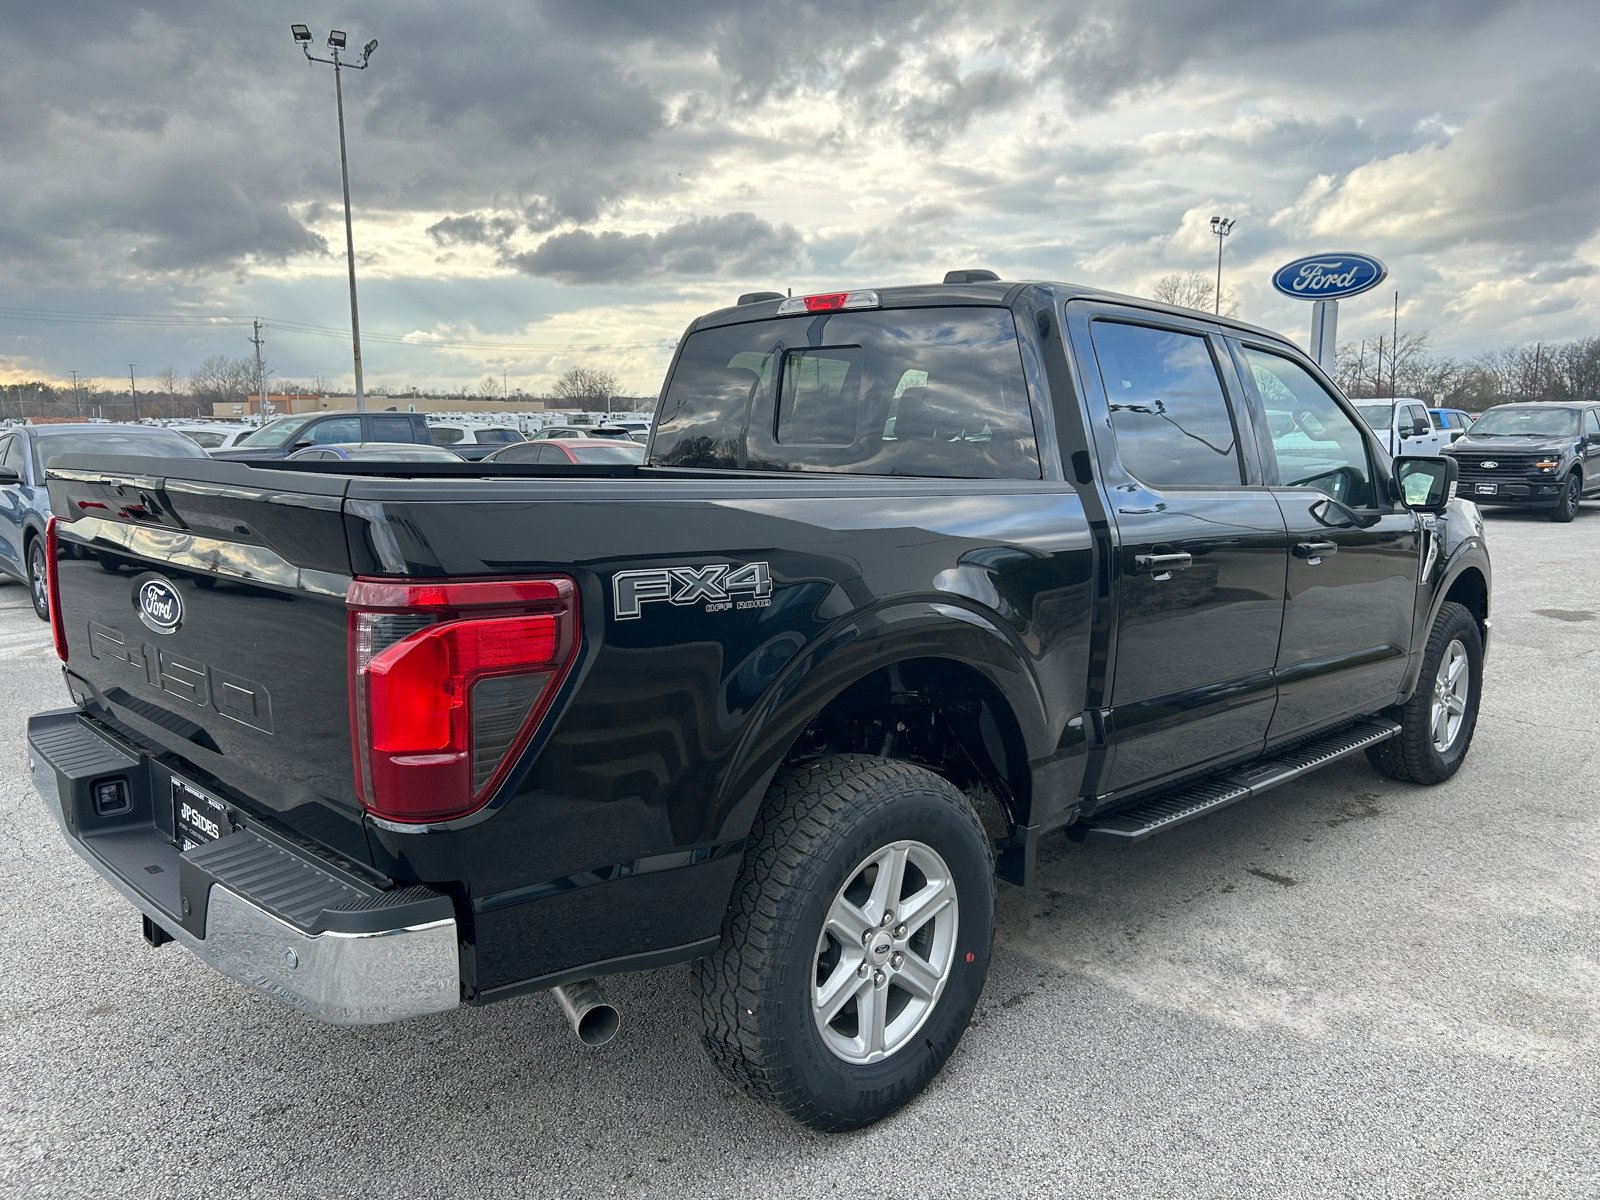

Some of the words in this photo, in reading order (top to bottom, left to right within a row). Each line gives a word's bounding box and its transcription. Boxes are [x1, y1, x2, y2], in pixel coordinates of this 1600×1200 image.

[1293, 262, 1358, 291] Ford
[146, 585, 172, 620] Ford
[612, 562, 773, 621] FX4
[706, 603, 733, 613] OFF
[737, 599, 772, 610] ROAD
[88, 620, 275, 736] F-150
[181, 802, 192, 821] JP
[192, 809, 219, 839] SIDES
